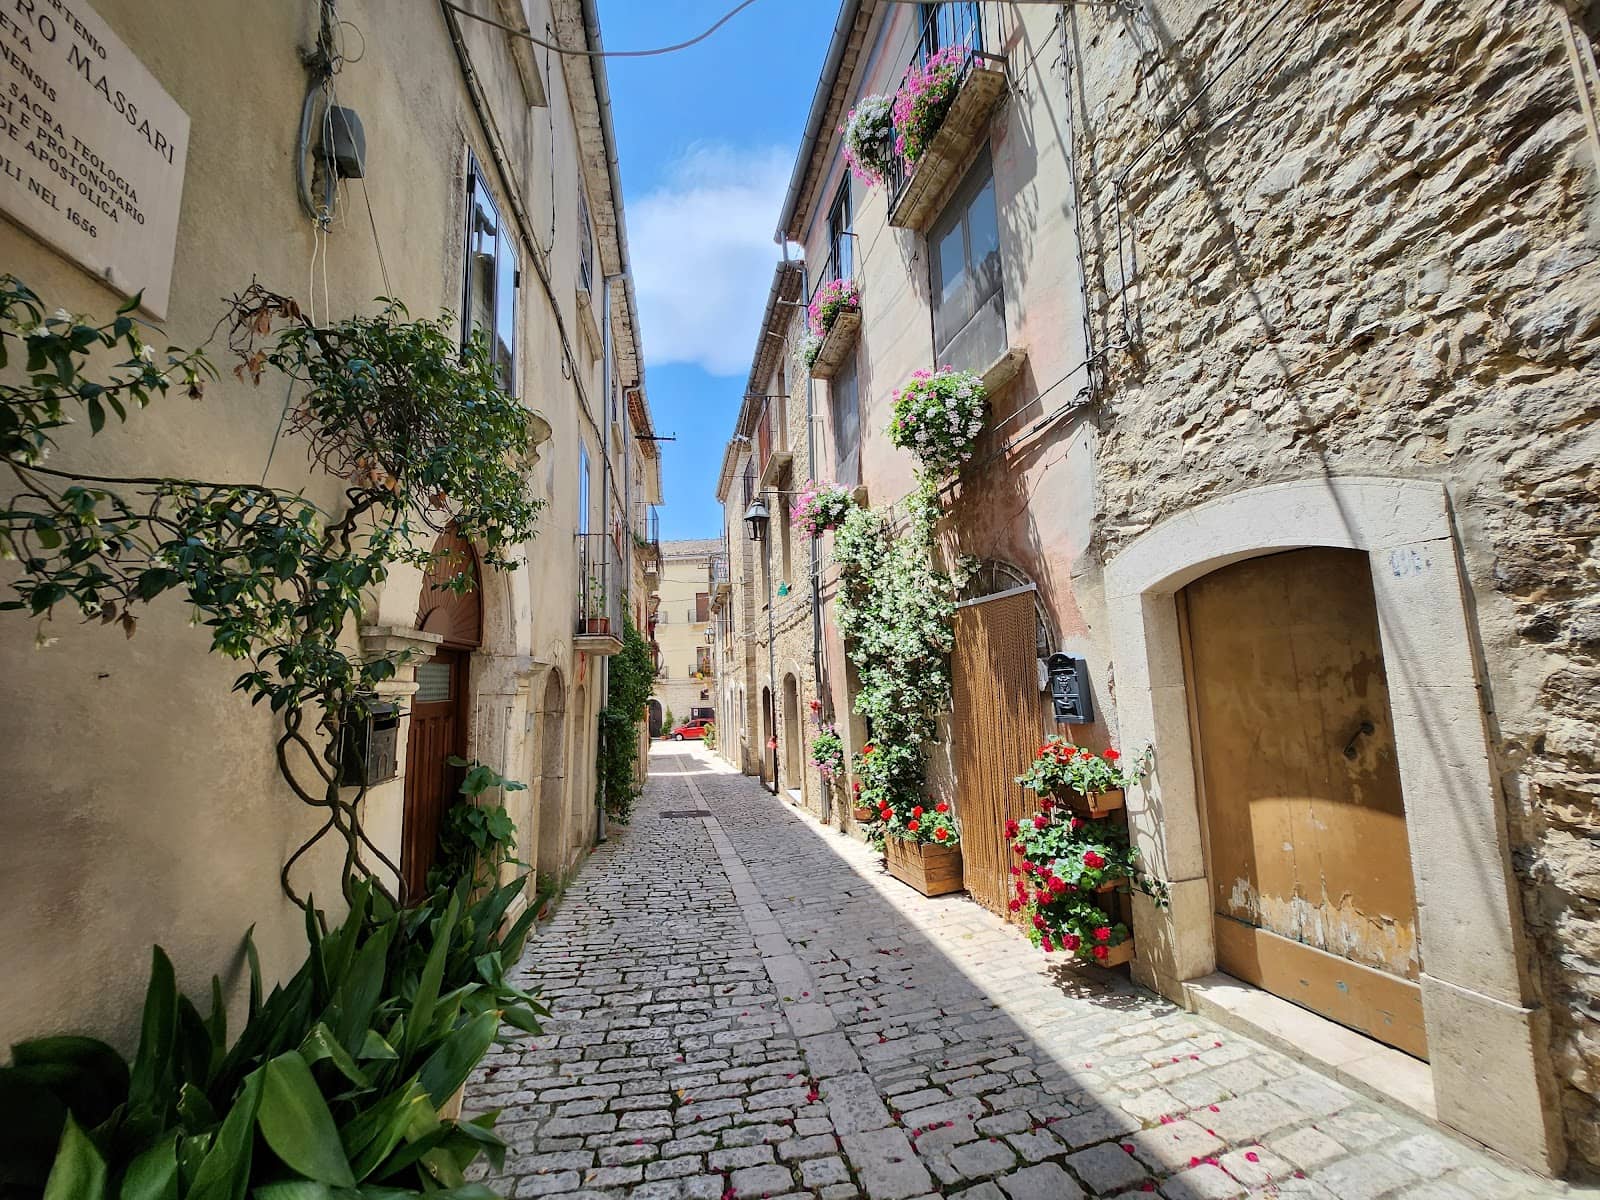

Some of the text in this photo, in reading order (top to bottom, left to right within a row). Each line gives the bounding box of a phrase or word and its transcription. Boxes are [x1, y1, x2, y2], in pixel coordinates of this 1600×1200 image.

[48, 0, 106, 60] RTENIO
[9, 82, 138, 203] SACRA TEOLOGIA
[66, 43, 175, 165] MASSARI
[20, 112, 31, 129] E
[37, 126, 144, 225] PROTONOTARIO
[24, 140, 118, 223] APOSTOLICA
[28, 176, 59, 212] NEL
[66, 207, 97, 238] 1656
